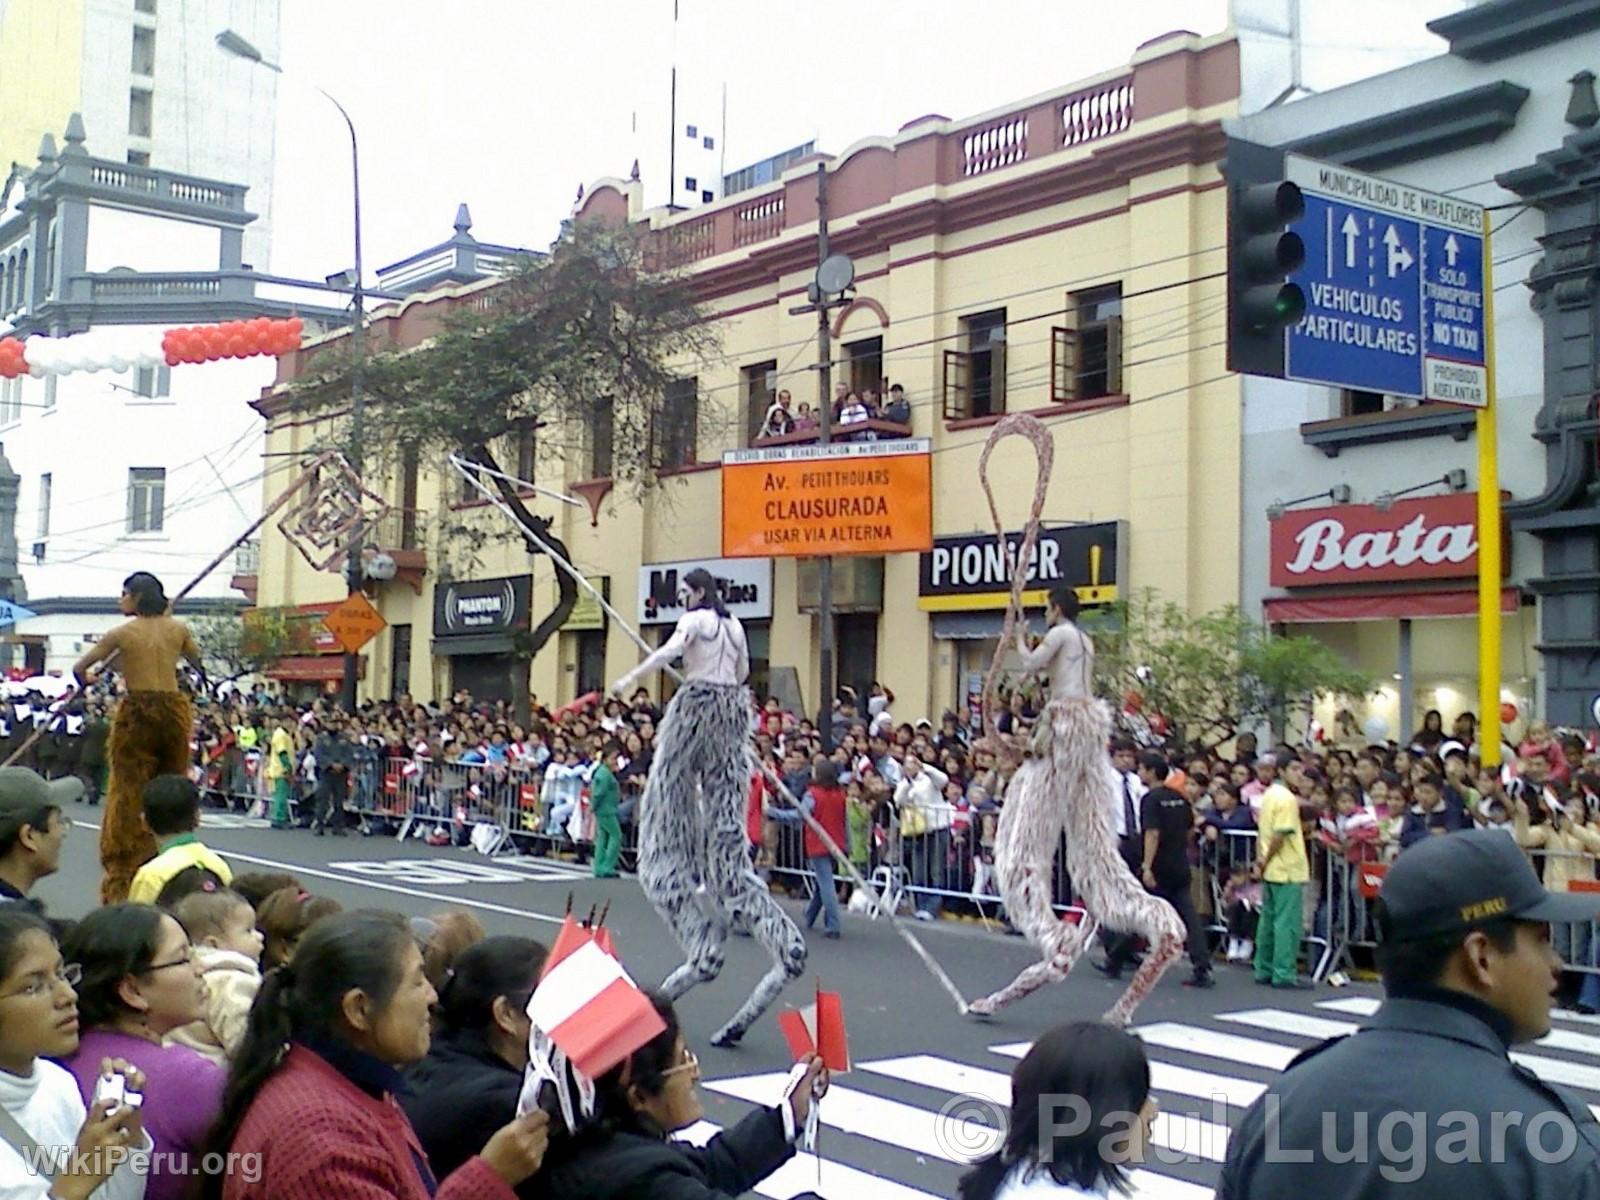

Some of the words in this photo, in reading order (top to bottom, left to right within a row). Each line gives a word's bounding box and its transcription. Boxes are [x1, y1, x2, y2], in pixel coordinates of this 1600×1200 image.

[1319, 170, 1398, 208] MUNICIPALIDAD
[1403, 190, 1417, 212] DE
[1421, 197, 1482, 229] MIRAFLORES
[1439, 267, 1467, 287] SOLO
[1310, 281, 1402, 322] VEHICULOS
[1433, 322, 1450, 345] NO
[1452, 327, 1478, 351] TAXI
[1433, 383, 1481, 402] ADELANTAR
[764, 473, 789, 491] Av.
[765, 496, 888, 520] CLAUSURADA
[764, 529, 800, 544] USAR
[804, 527, 826, 542] VIA
[830, 525, 892, 541] ALTERNA
[1285, 513, 1478, 574] Bata
[458, 597, 501, 614] PHANTOM
[1459, 897, 1507, 922] PERU
